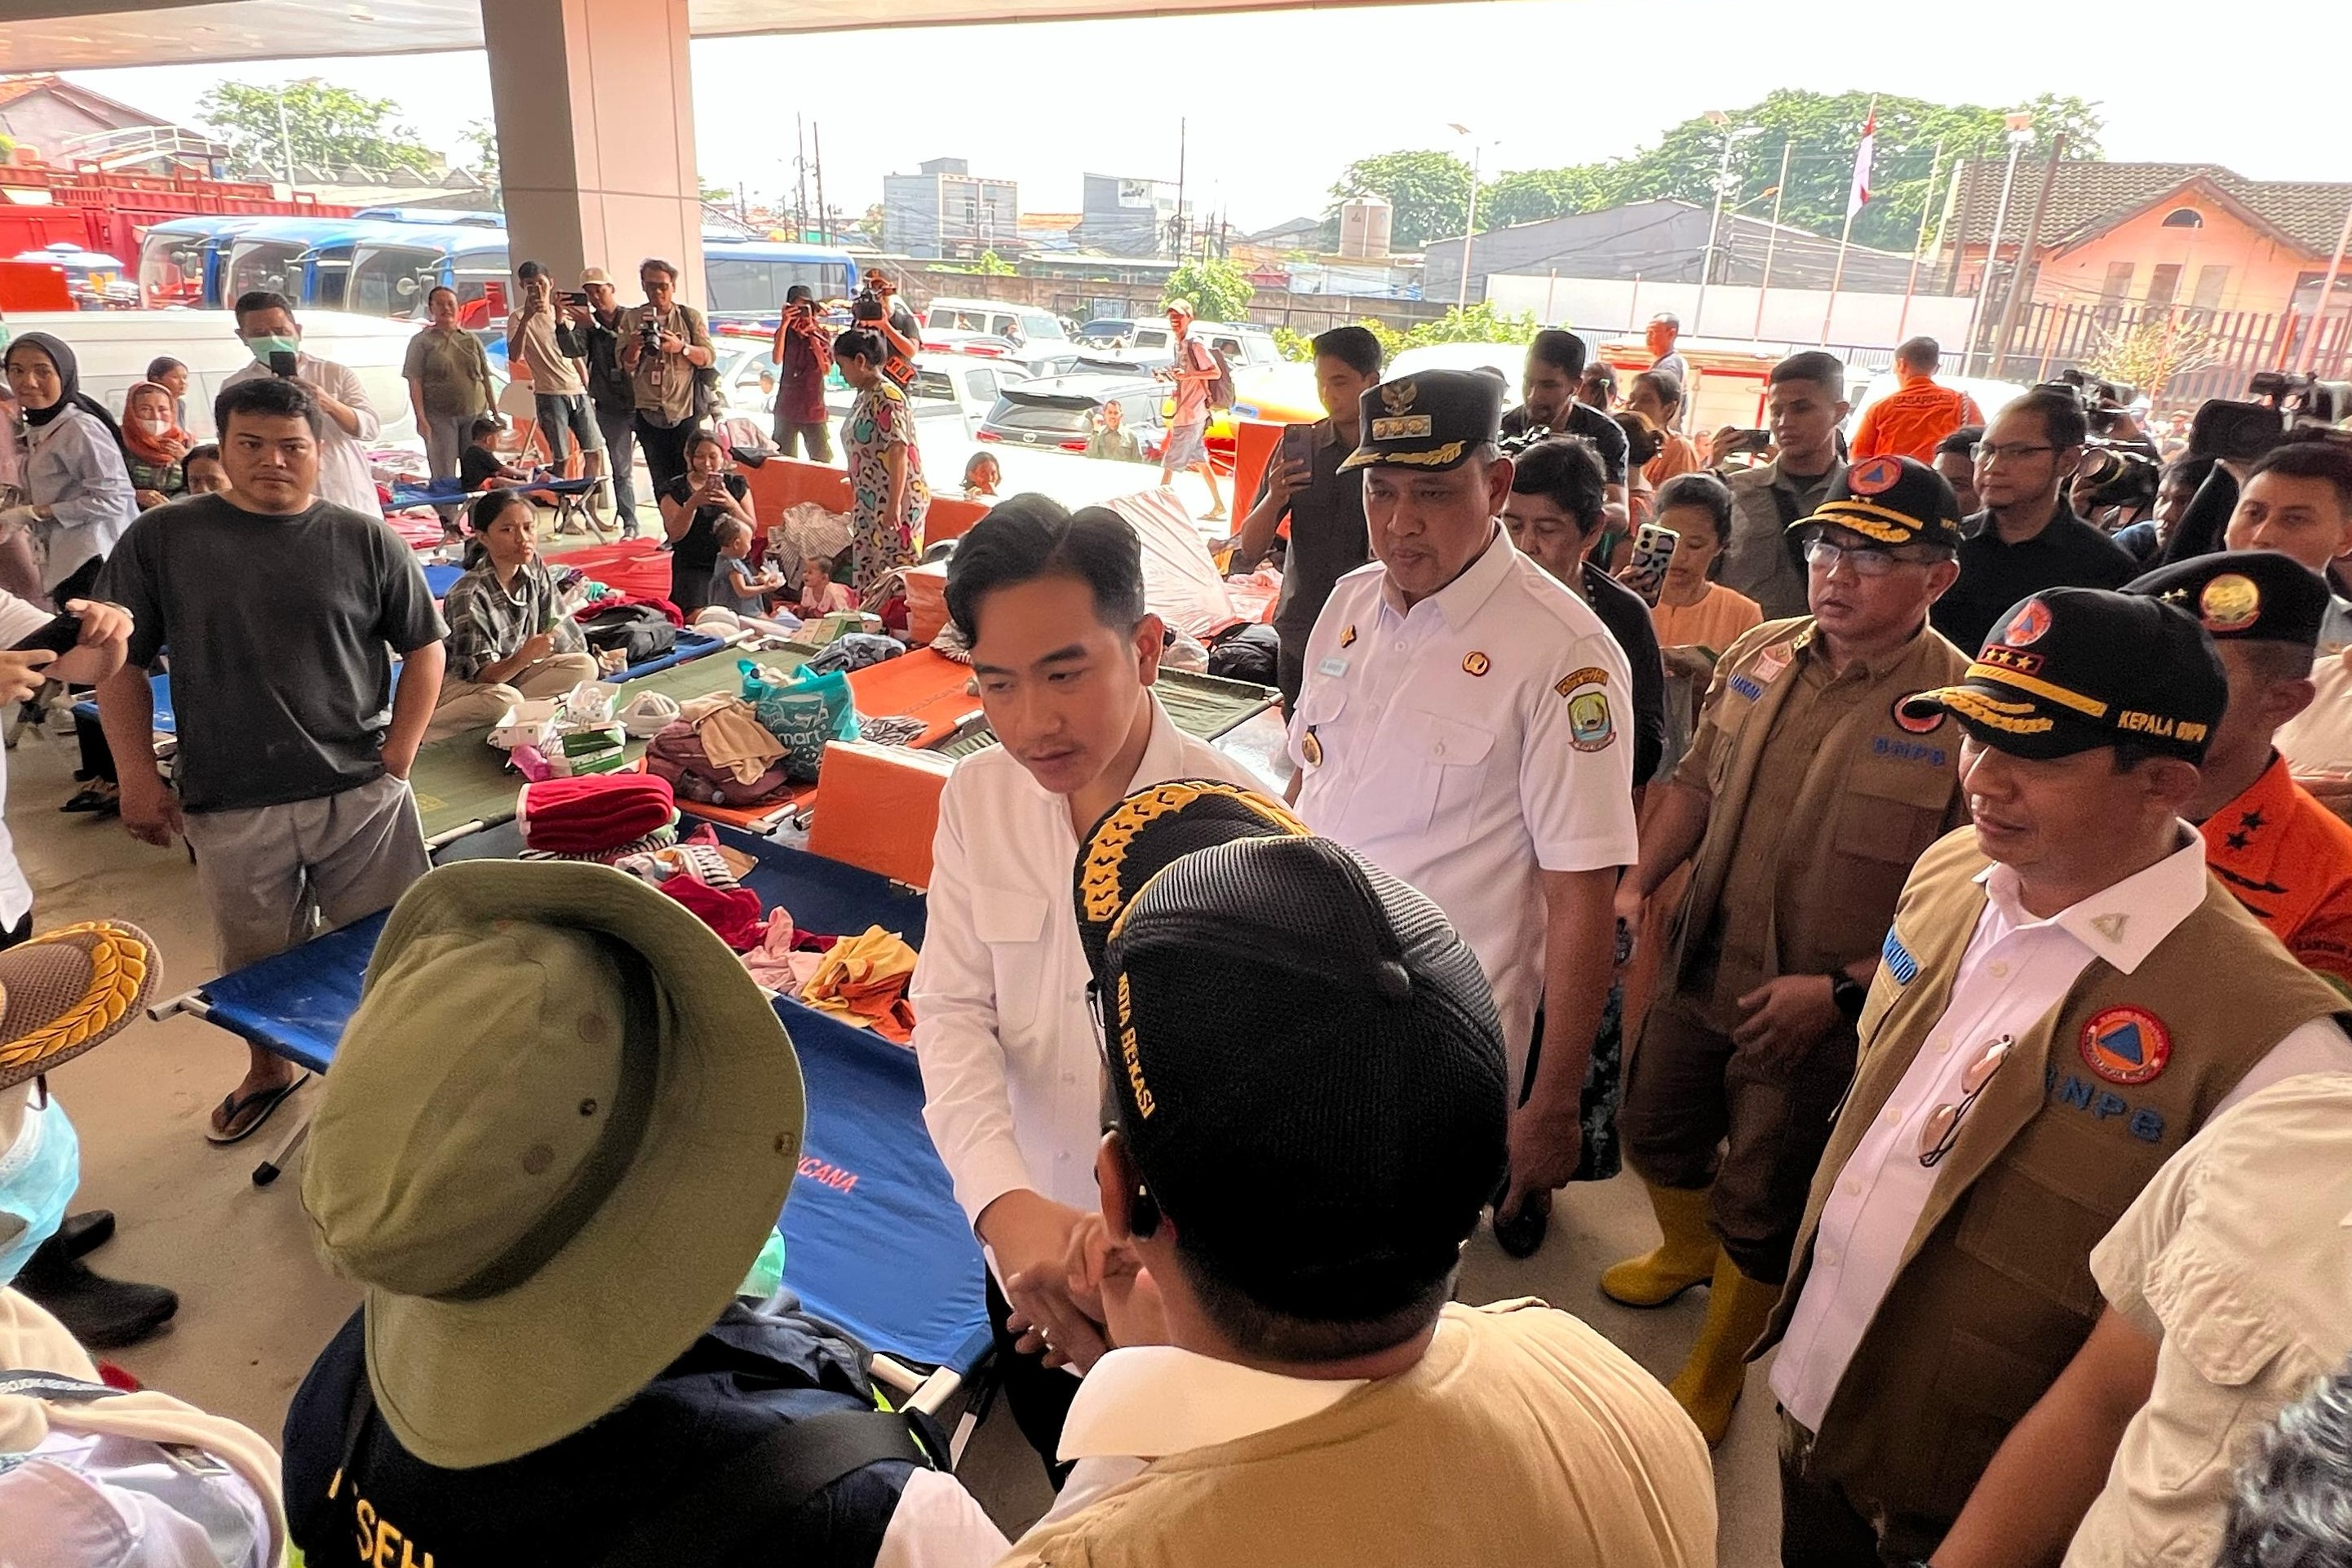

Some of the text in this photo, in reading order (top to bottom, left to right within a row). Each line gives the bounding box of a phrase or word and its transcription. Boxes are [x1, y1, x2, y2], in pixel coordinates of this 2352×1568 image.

[2118, 711, 2173, 737] KEPALA
[777, 729, 822, 746] mart
[1121, 1027, 1156, 1119] BEKASI
